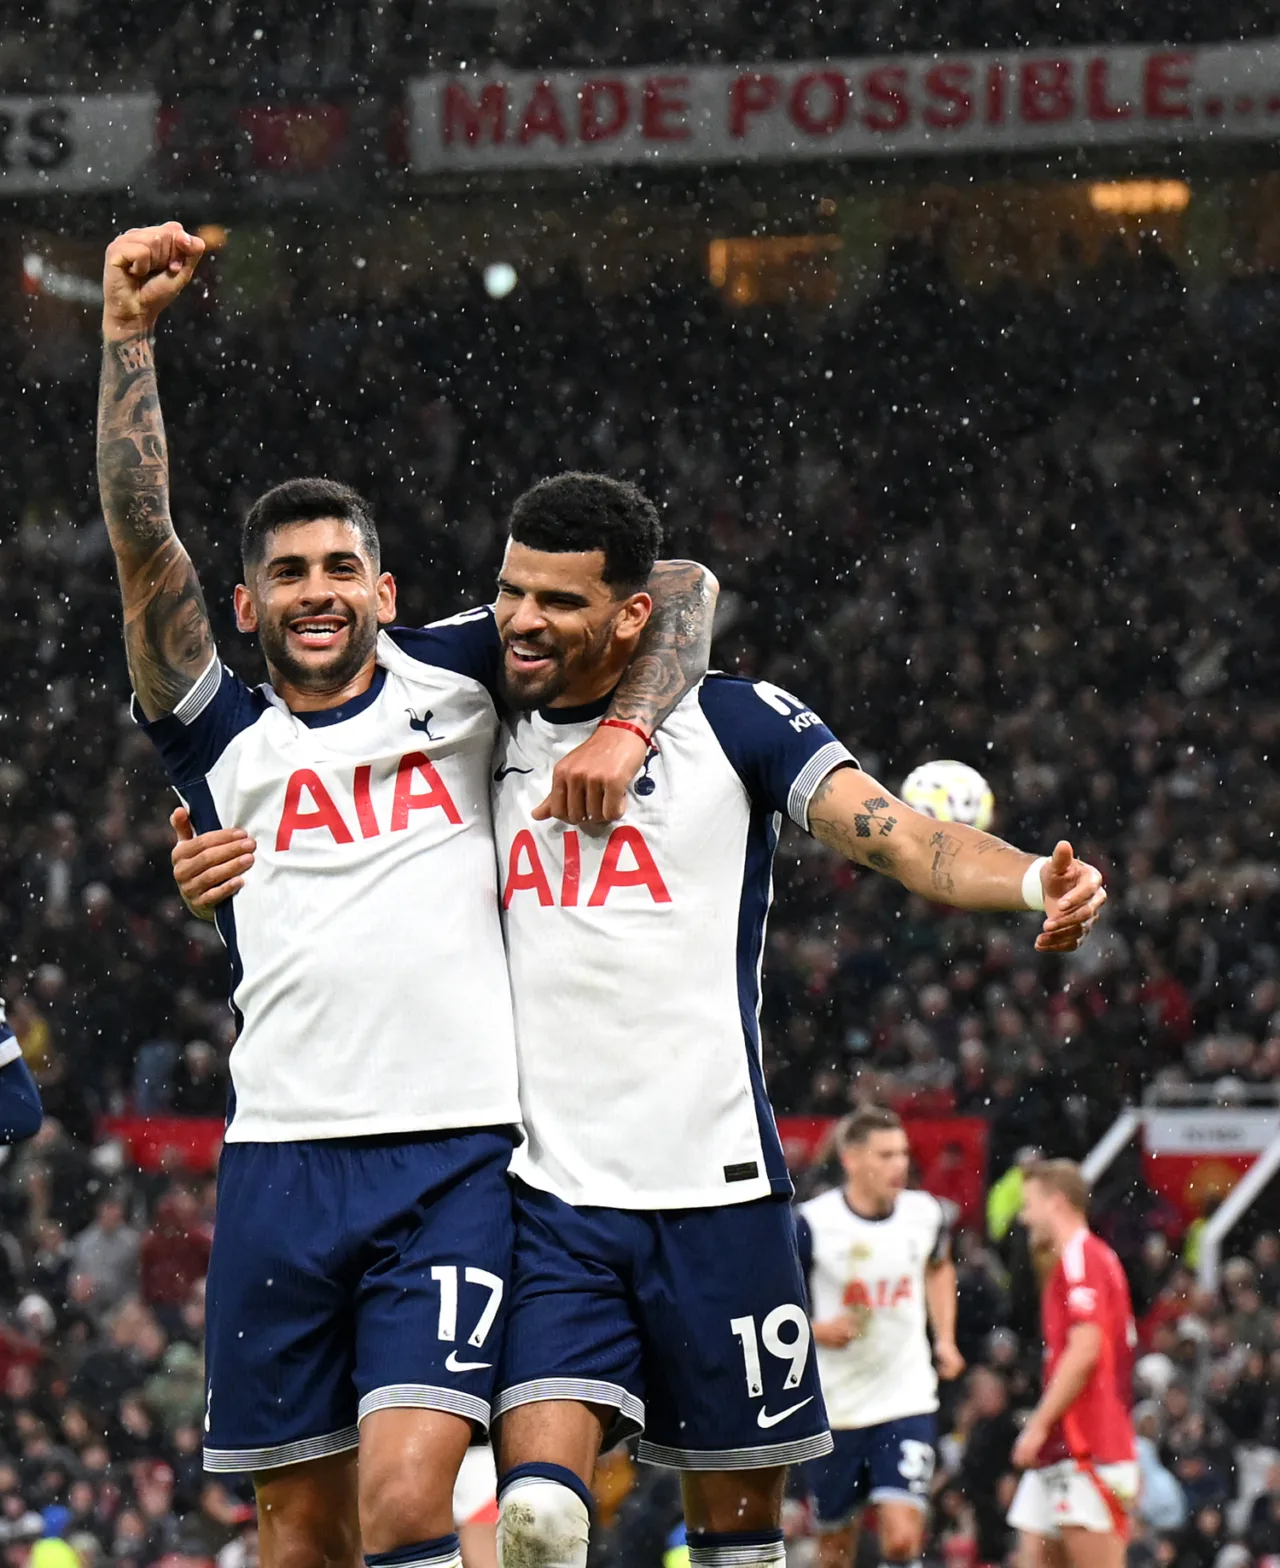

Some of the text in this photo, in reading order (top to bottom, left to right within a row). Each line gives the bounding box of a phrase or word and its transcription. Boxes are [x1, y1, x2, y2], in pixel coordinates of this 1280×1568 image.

[442, 76, 693, 148] MADE
[788, 711, 824, 733] Kra
[275, 751, 464, 852] AIA
[502, 825, 673, 911] AIA
[431, 1265, 504, 1349] 17
[841, 1277, 913, 1308] AIA
[730, 1303, 811, 1398] 19
